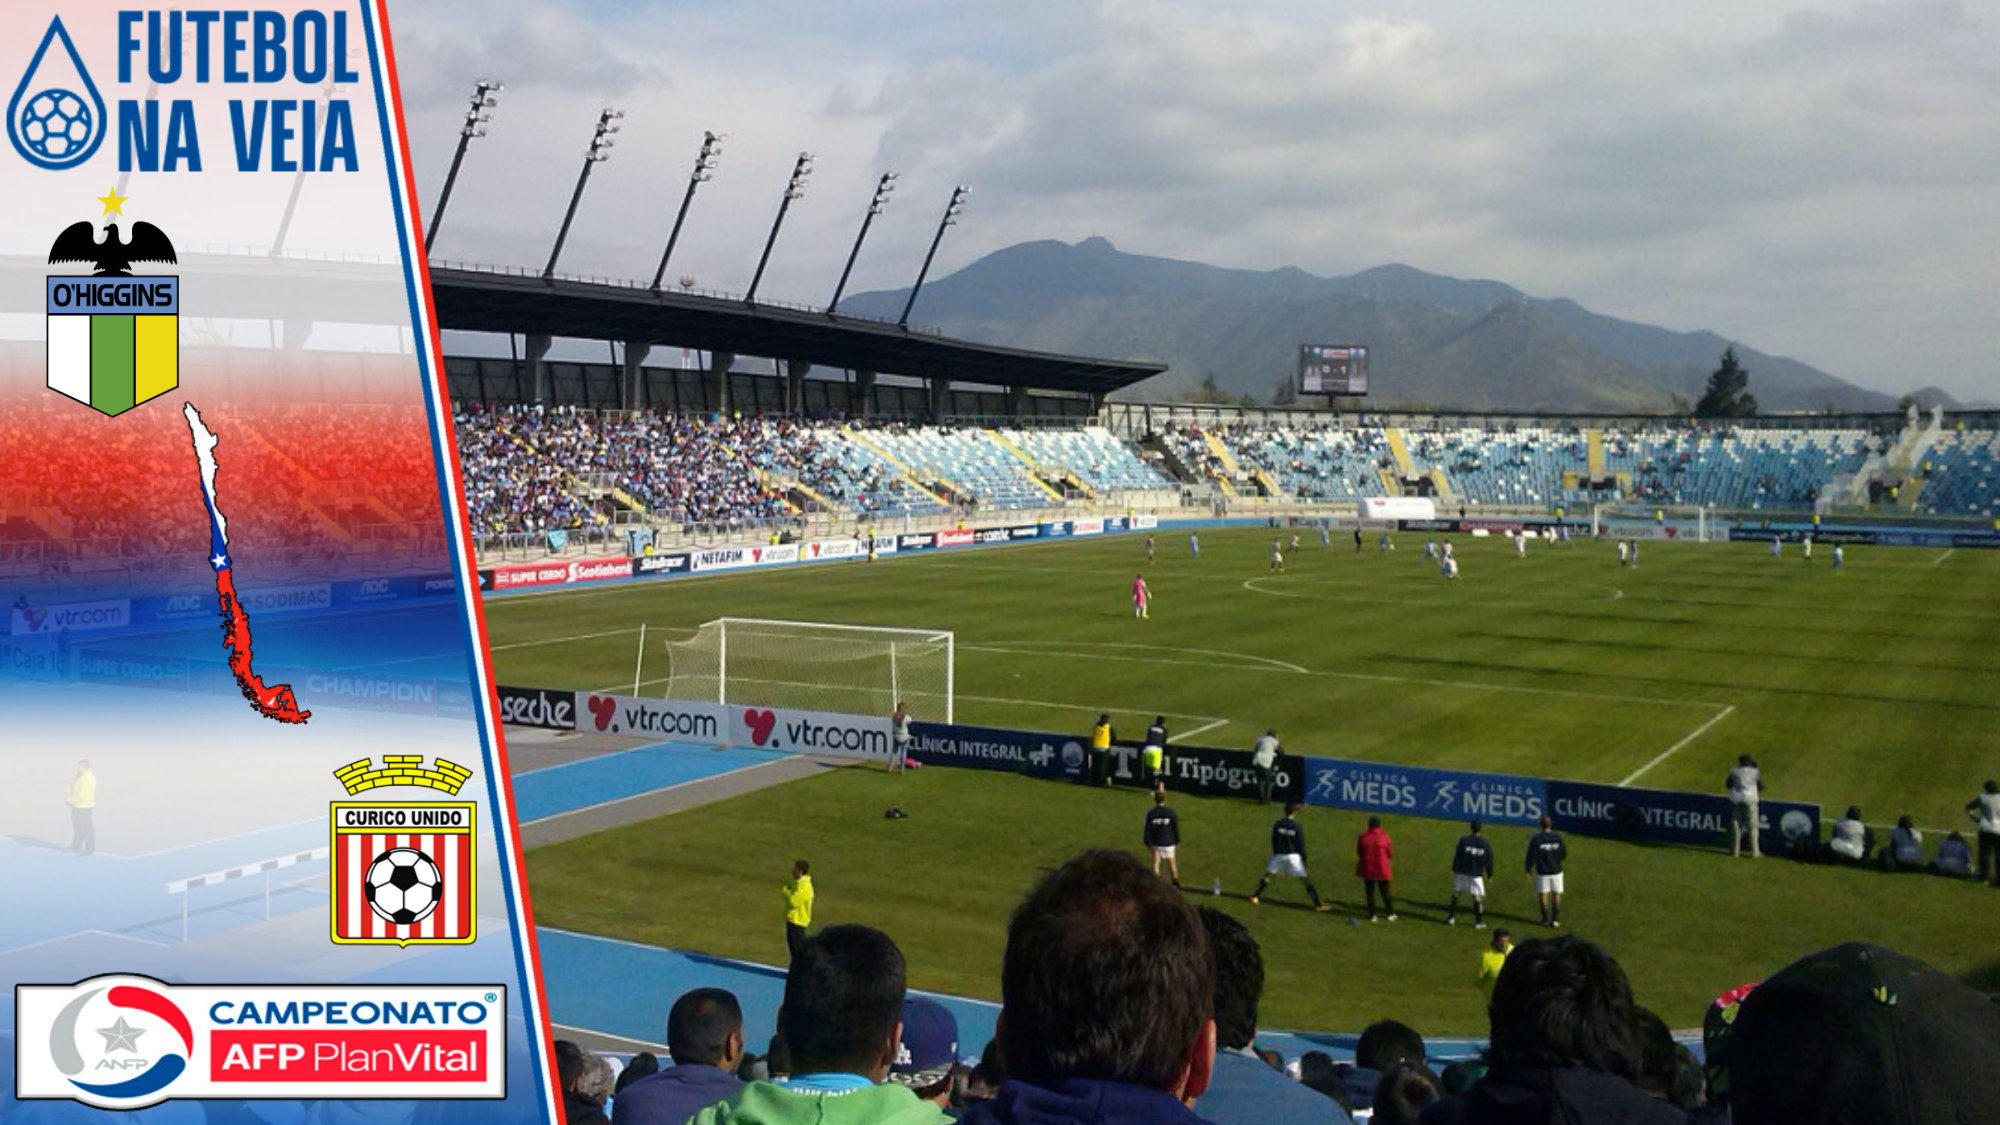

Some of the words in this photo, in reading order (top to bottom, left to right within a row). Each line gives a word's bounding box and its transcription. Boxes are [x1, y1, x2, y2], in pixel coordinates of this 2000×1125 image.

[578, 562, 633, 578] Scotiabank
[702, 550, 742, 564] NETAFIM
[510, 571, 538, 584] SUPER
[254, 589, 328, 610] SODIMAC
[54, 606, 122, 626] vtr.com
[13, 646, 46, 675] Caja
[81, 657, 118, 676] SUPER
[121, 661, 163, 680] CERDO
[307, 675, 433, 702] CHAMPION
[499, 691, 575, 728] seche
[626, 706, 717, 738] vtr.com
[786, 721, 889, 755] vtr.com
[907, 734, 957, 754] CLÍNICA
[959, 740, 1026, 762] INTEGRAL
[1350, 769, 1408, 784] CLINICA
[1471, 782, 1534, 796] CLINICA
[1342, 779, 1417, 809] MEDS
[1463, 791, 1543, 820] MEDS
[1555, 795, 1616, 822] CLÍNIC
[1638, 806, 1727, 833] NTEGRAL
